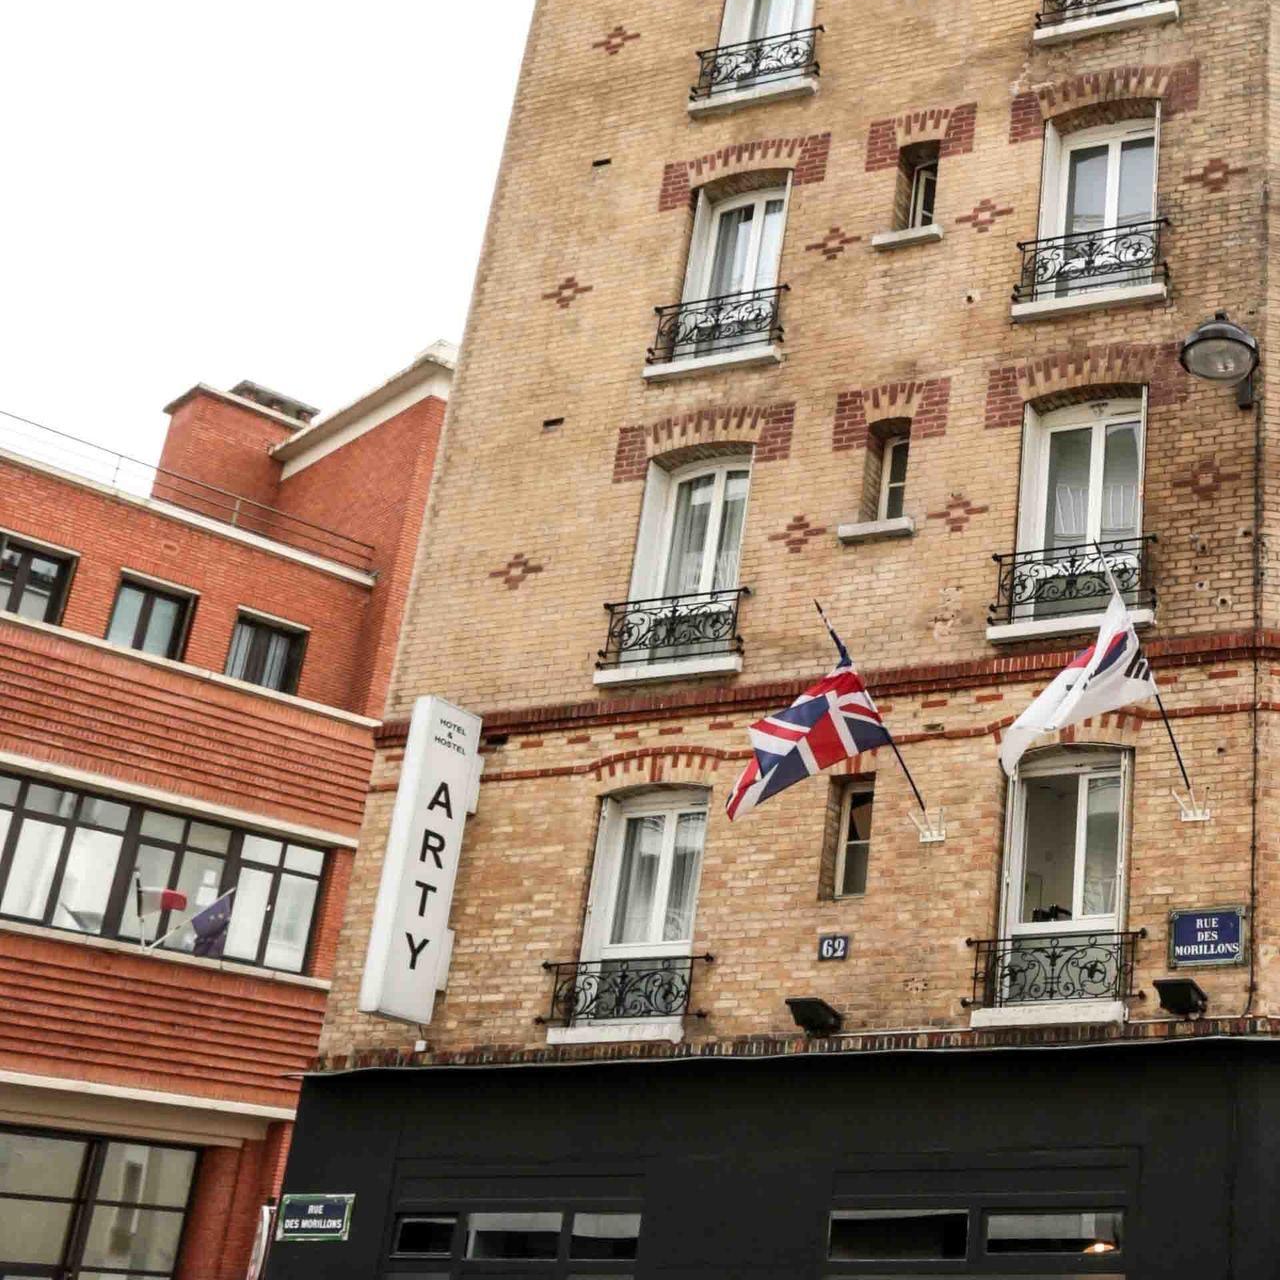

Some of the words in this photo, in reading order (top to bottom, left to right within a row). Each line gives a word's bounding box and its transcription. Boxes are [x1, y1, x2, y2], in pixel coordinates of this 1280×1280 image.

[440, 718, 466, 736] HOTEL
[434, 736, 466, 756] HOSTEL
[404, 781, 453, 970] ARTY
[1196, 918, 1219, 928] RUE
[1197, 931, 1218, 942] DES
[822, 938, 845, 958] 62
[1175, 942, 1239, 956] MORILLONS
[307, 1204, 324, 1214] RUE
[284, 1218, 300, 1228] DES
[301, 1218, 342, 1229] MORILLONS
